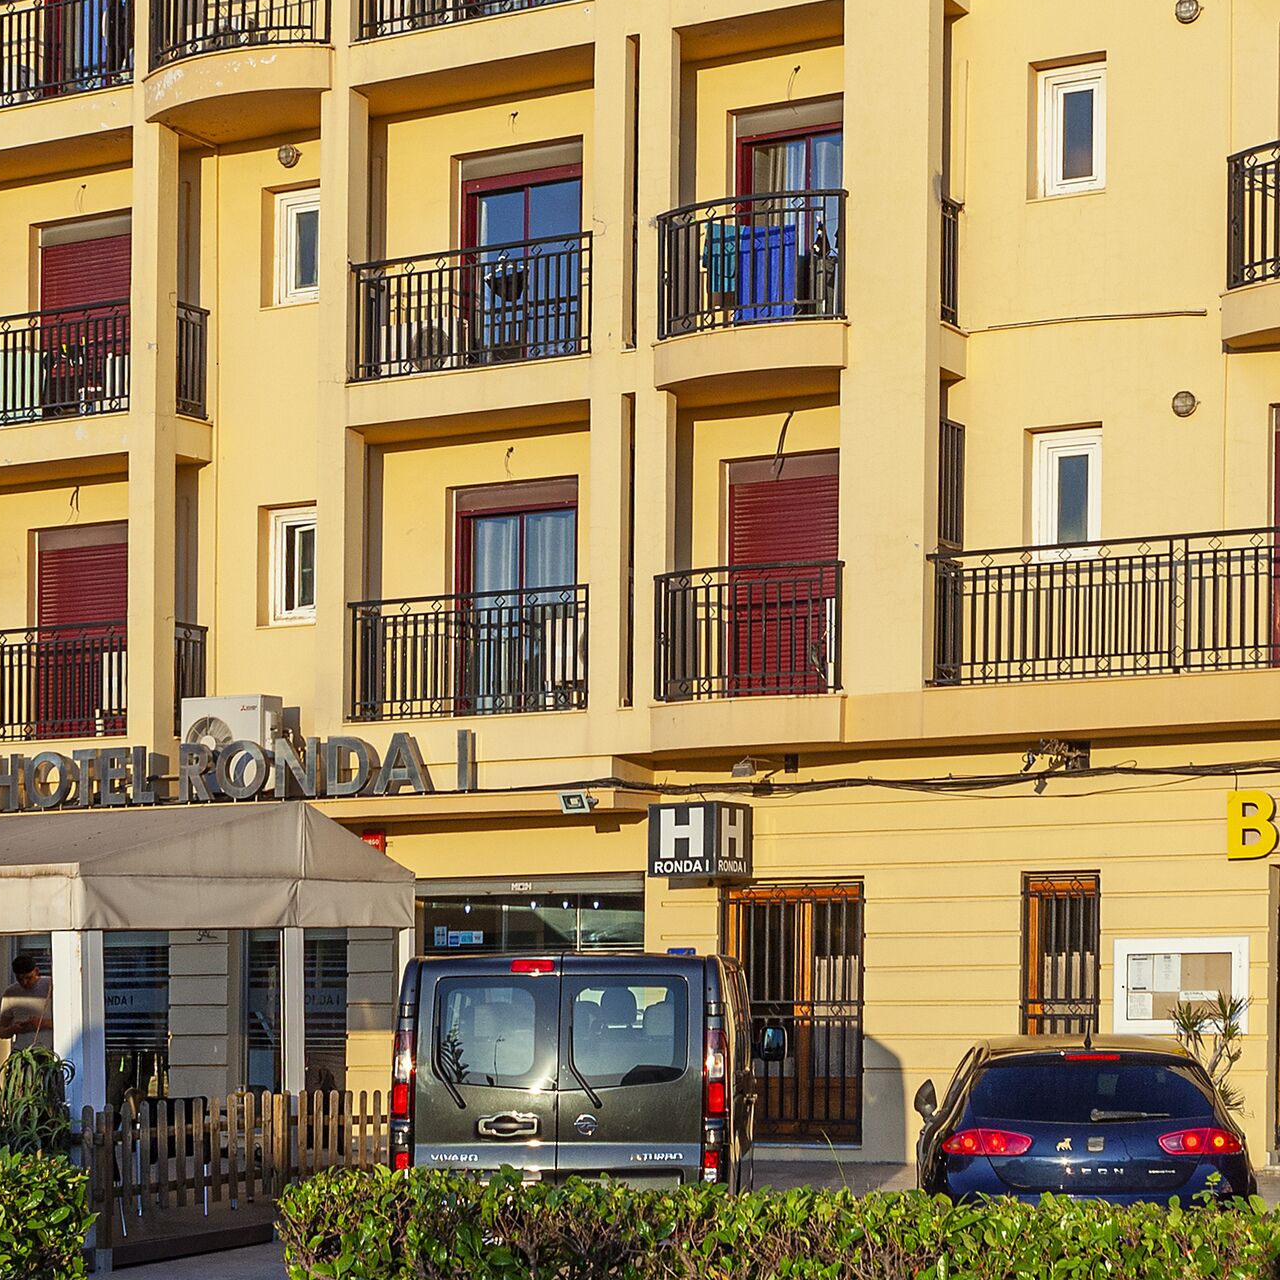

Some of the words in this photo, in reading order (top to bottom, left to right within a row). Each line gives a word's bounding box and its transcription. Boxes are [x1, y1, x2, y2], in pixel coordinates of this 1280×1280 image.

[178, 731, 432, 803] RONDA
[456, 728, 478, 791] I
[660, 807, 704, 858] H
[721, 807, 744, 858] H
[654, 860, 703, 873] RONDA
[705, 859, 710, 872] I
[718, 860, 743, 873] RONDA
